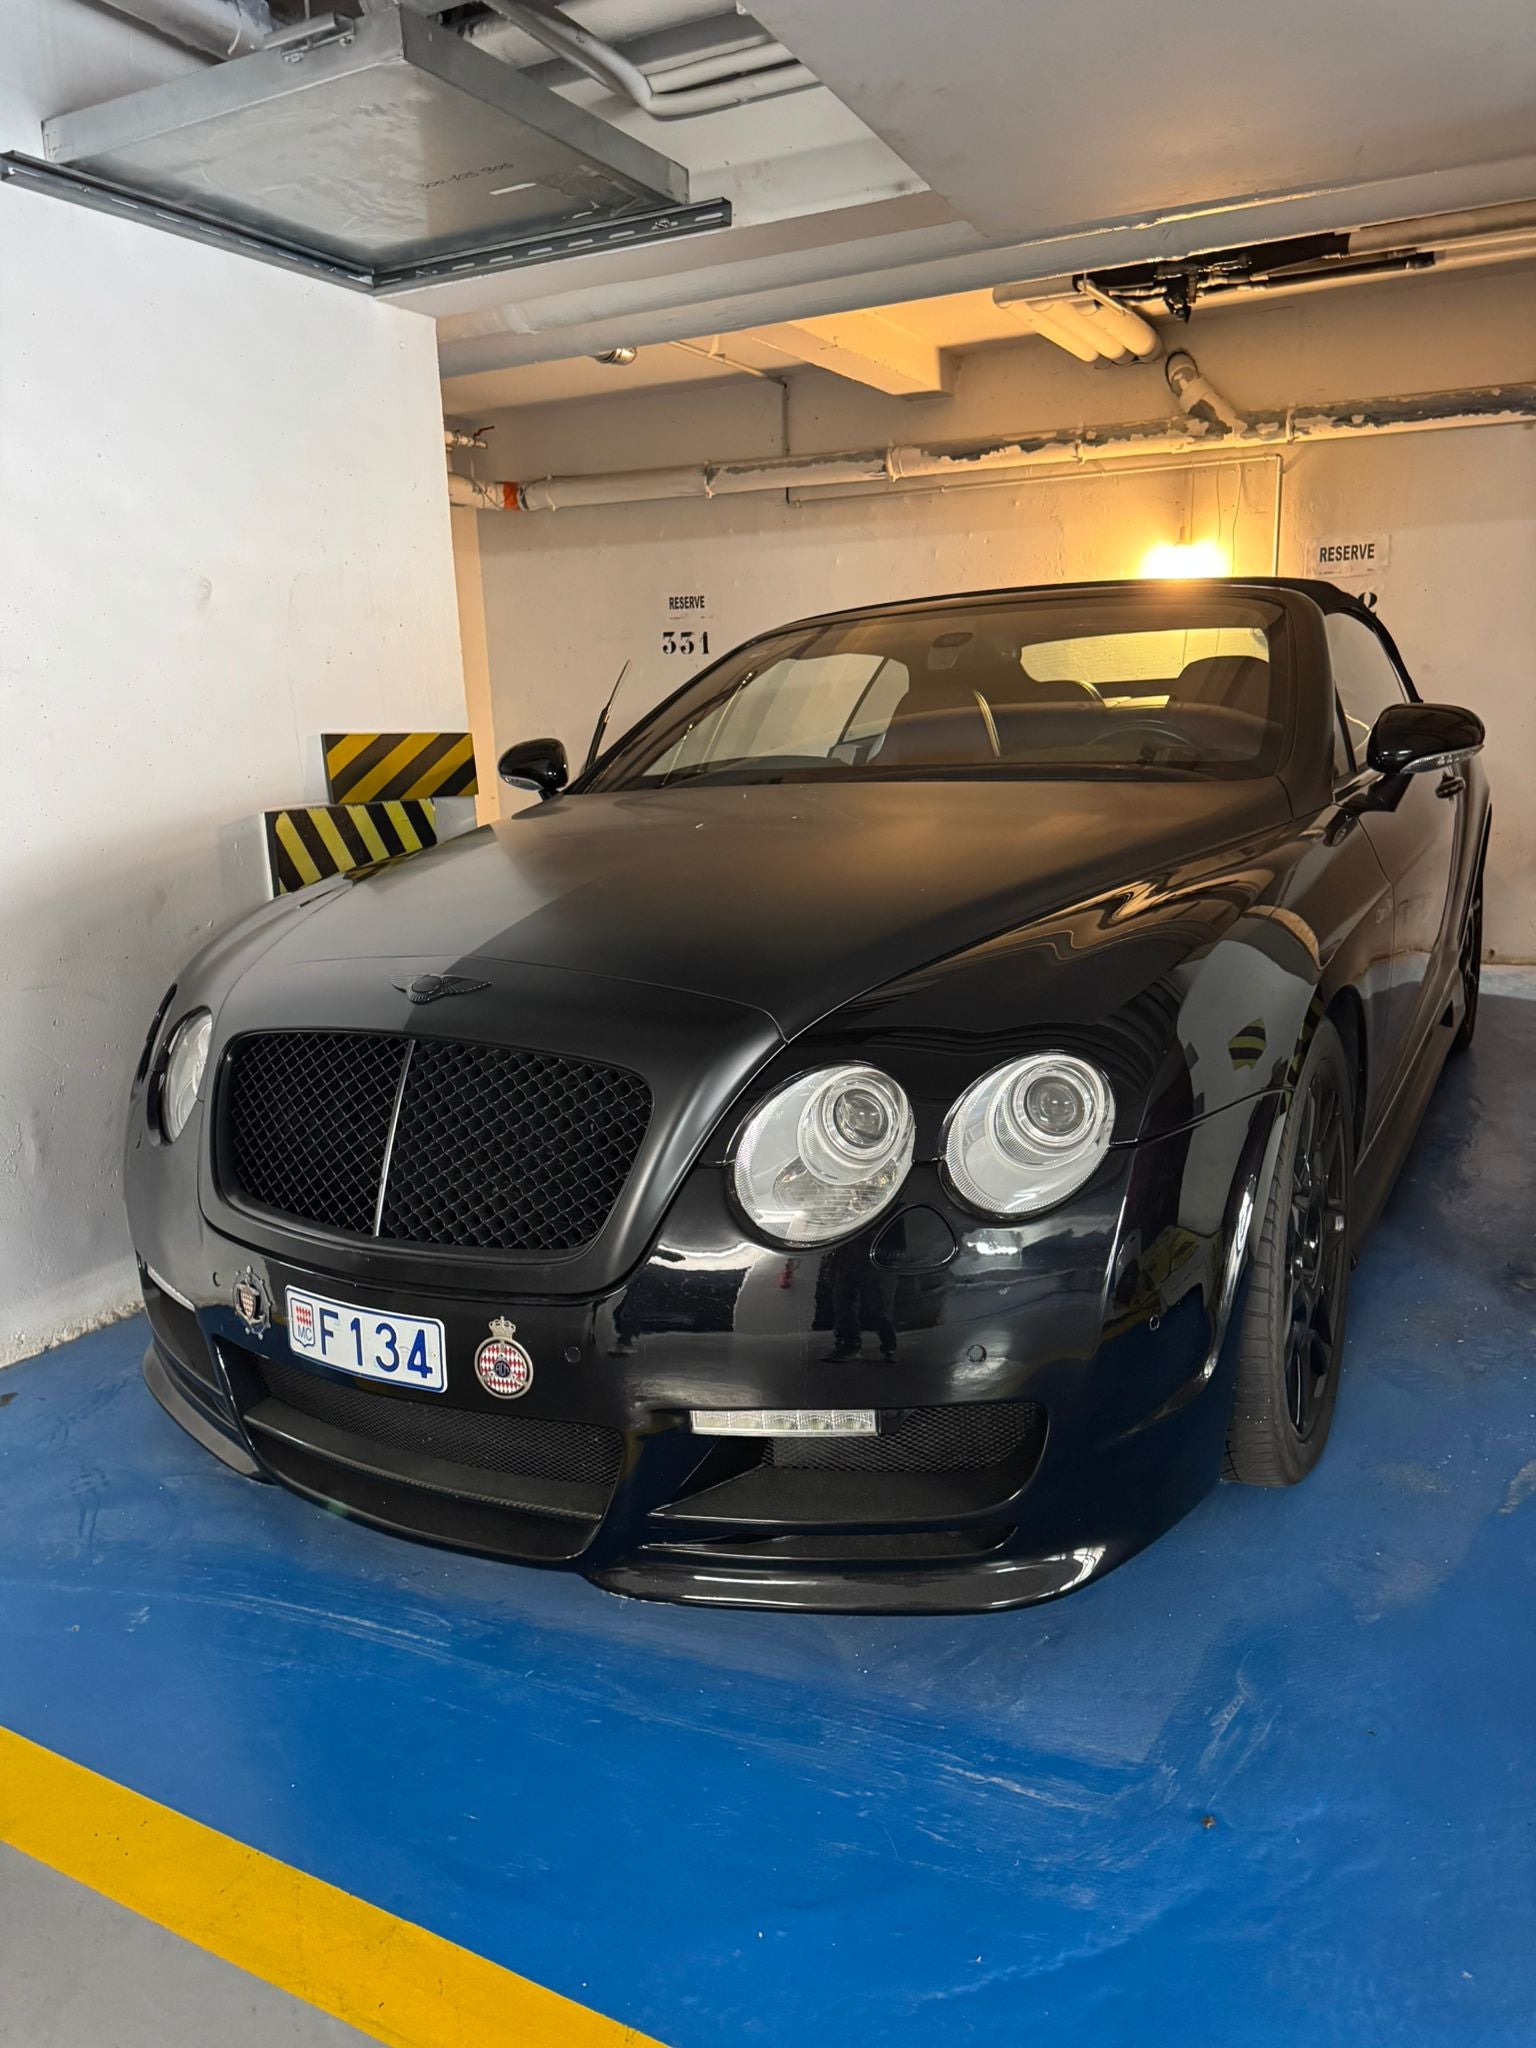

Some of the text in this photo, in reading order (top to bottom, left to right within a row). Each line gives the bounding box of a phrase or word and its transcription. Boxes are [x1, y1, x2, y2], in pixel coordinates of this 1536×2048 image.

[1319, 543, 1375, 563] RESERVE
[668, 595, 705, 610] RESERVE
[662, 631, 709, 655] 331
[297, 1324, 313, 1341] MC
[319, 1307, 433, 1379] F134
